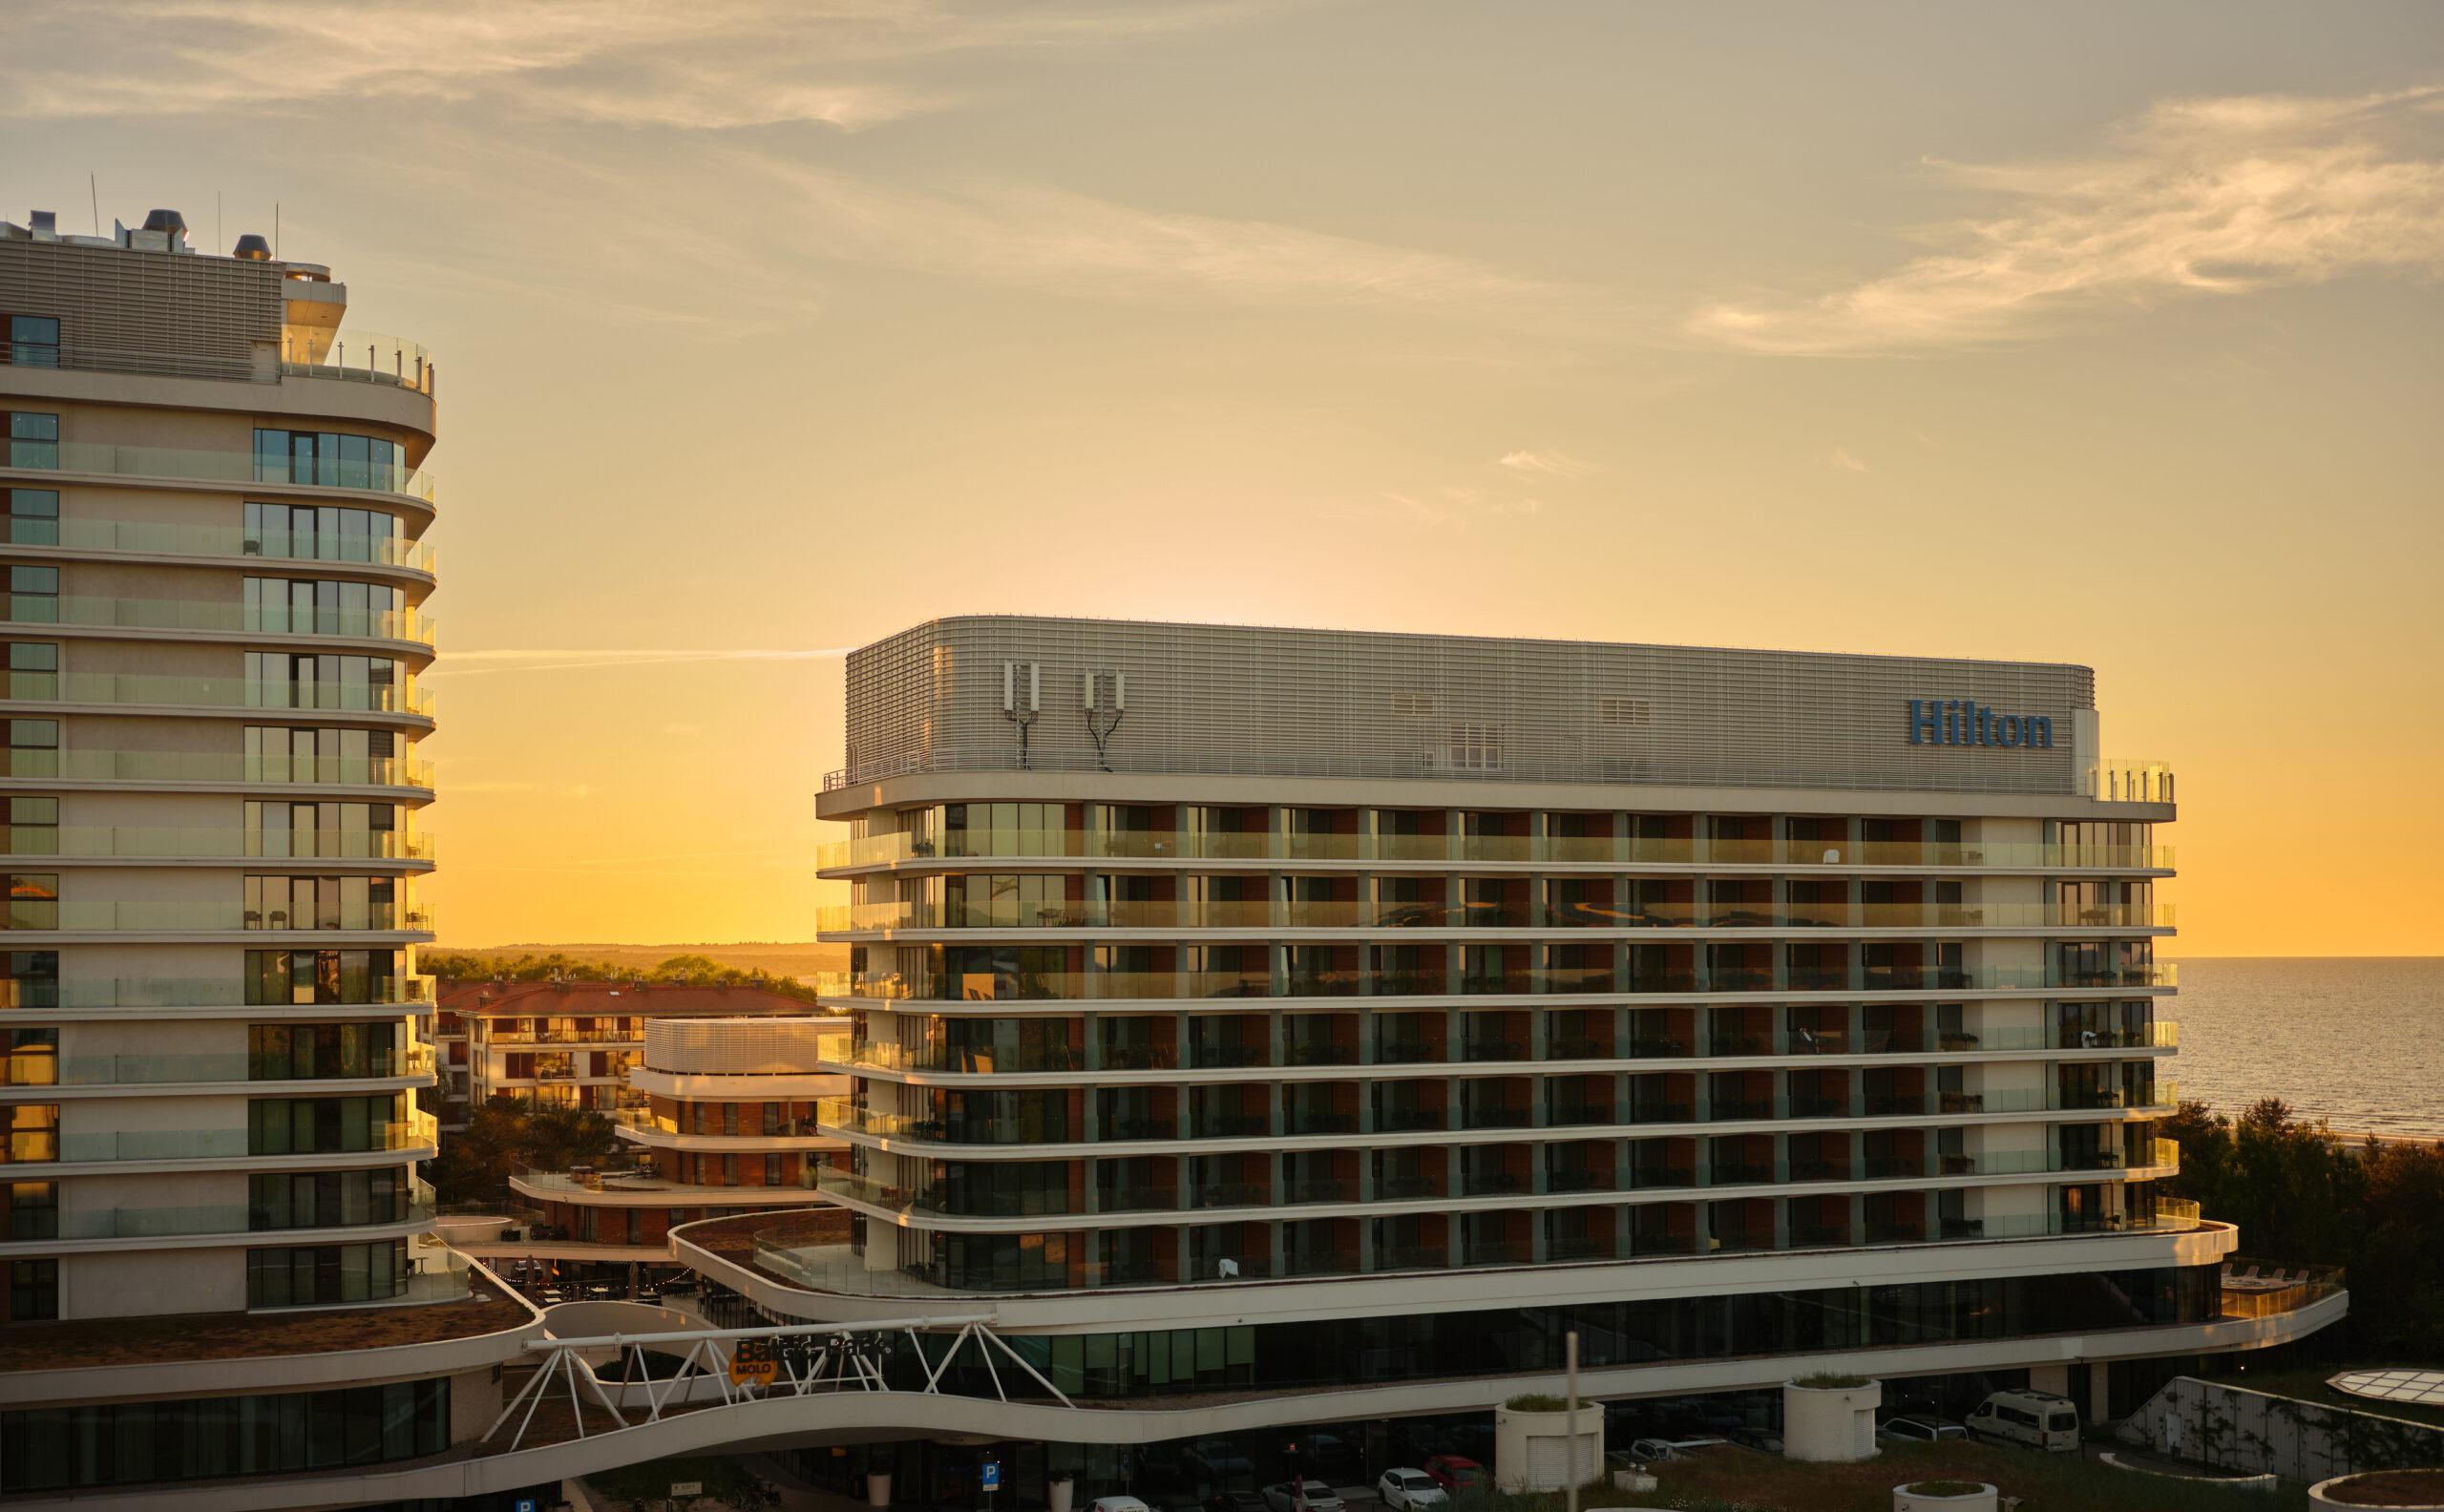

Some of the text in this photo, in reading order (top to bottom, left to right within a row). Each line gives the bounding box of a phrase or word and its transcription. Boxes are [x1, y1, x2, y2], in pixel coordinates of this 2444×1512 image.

[1909, 699, 2054, 748] Hilton
[736, 1363, 771, 1376] MOLO
[986, 1465, 996, 1480] P
